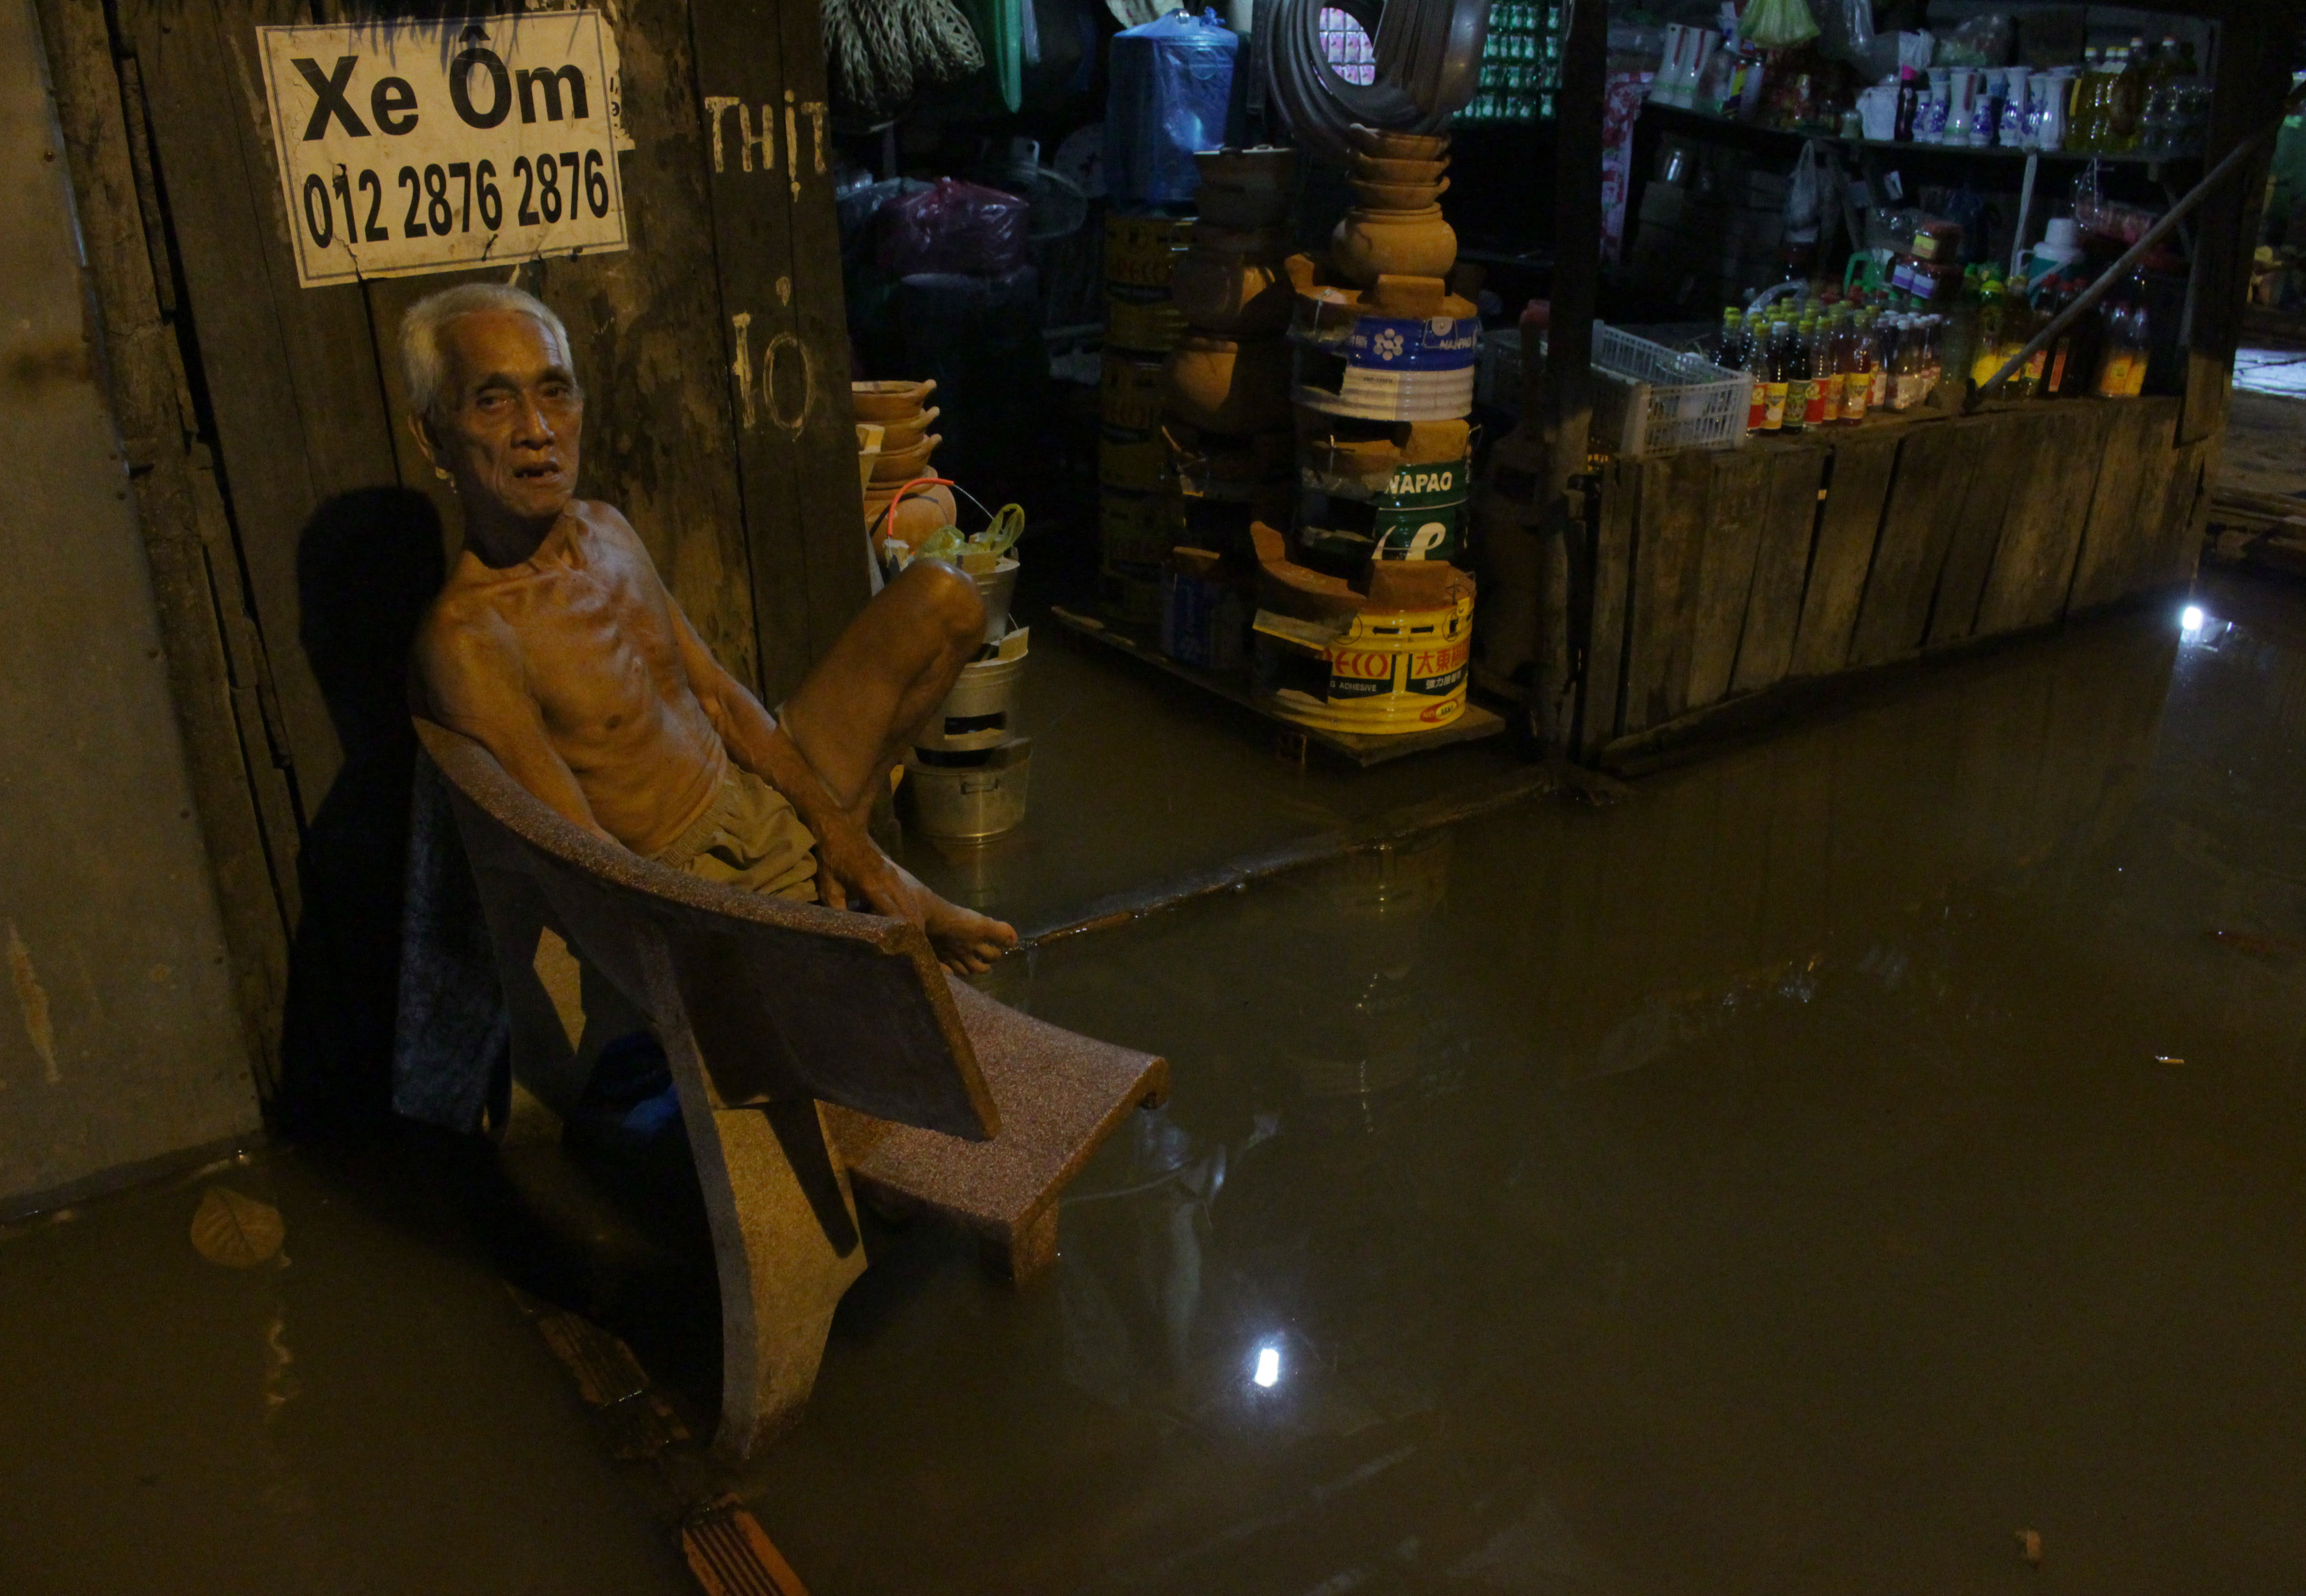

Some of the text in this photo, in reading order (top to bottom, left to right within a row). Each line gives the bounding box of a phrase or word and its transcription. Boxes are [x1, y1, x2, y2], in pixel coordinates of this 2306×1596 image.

[291, 54, 419, 141] Xe
[449, 24, 589, 130] Ôm
[303, 148, 609, 249] 012 2876 2876
[1339, 681, 1378, 692] ADHESIVE
